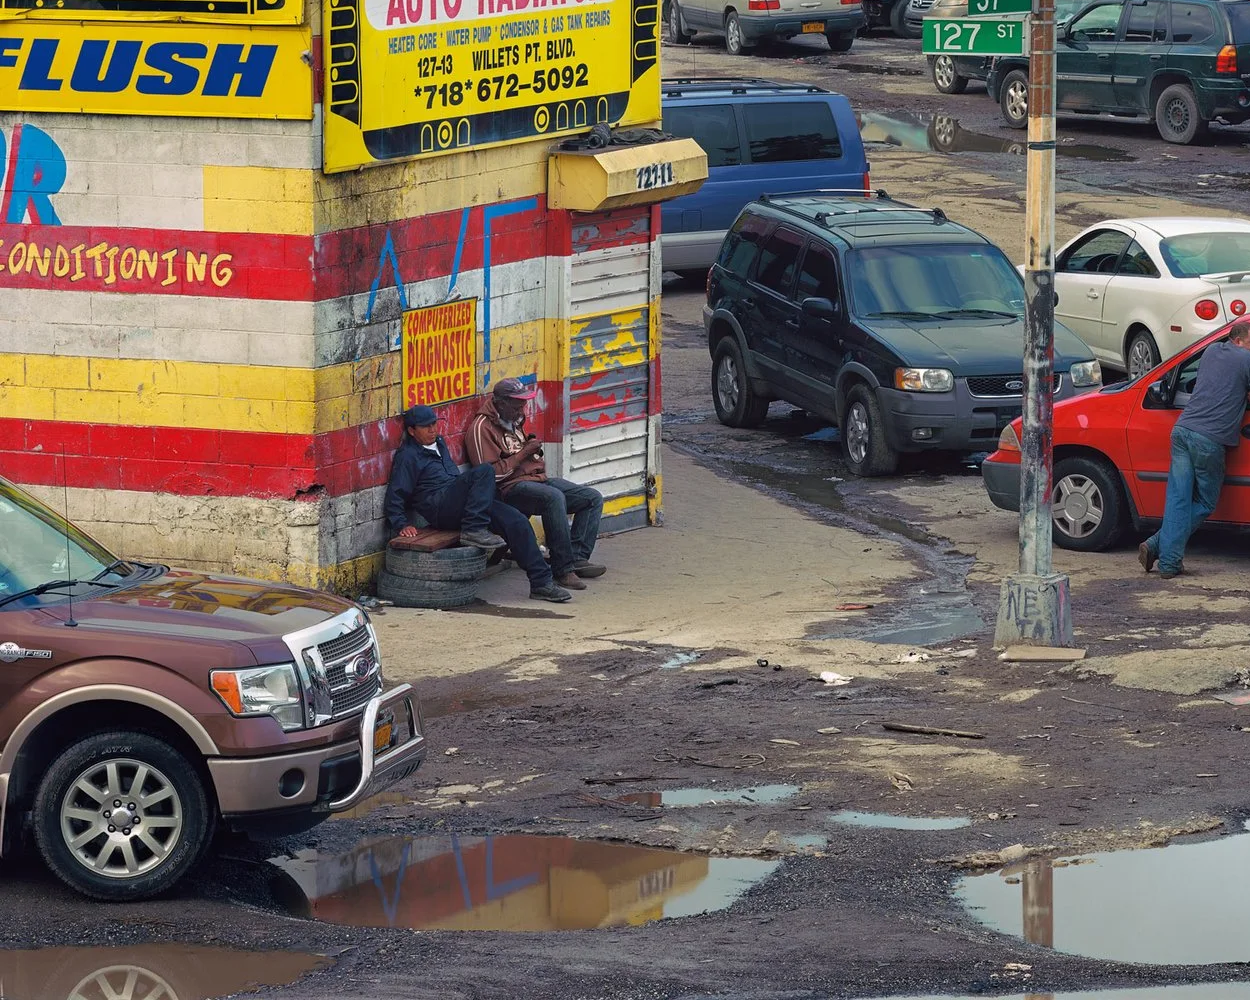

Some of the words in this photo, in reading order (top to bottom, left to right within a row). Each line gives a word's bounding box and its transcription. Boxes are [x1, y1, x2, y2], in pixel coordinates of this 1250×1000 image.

[389, 36, 416, 54] HEATER
[418, 33, 437, 49] CORE
[447, 29, 470, 47] WATER
[472, 27, 492, 44] PUMP
[500, 20, 540, 41] CONDENSOR
[543, 20, 548, 32] &
[551, 18, 564, 32] GAS
[567, 15, 583, 31] TANK
[585, 10, 611, 28] REPAIRS
[933, 23, 981, 50] 127
[997, 24, 1016, 38] ST
[417, 55, 453, 78] 127-13
[472, 47, 520, 72] WILLETS
[525, 43, 542, 64] PT.
[546, 38, 576, 60] BLVD.
[477, 63, 589, 102] 672-5092
[407, 302, 471, 337] COMPUTERIZED
[408, 328, 471, 381] DIAGNOSTIC
[408, 371, 471, 408] SERVICE
